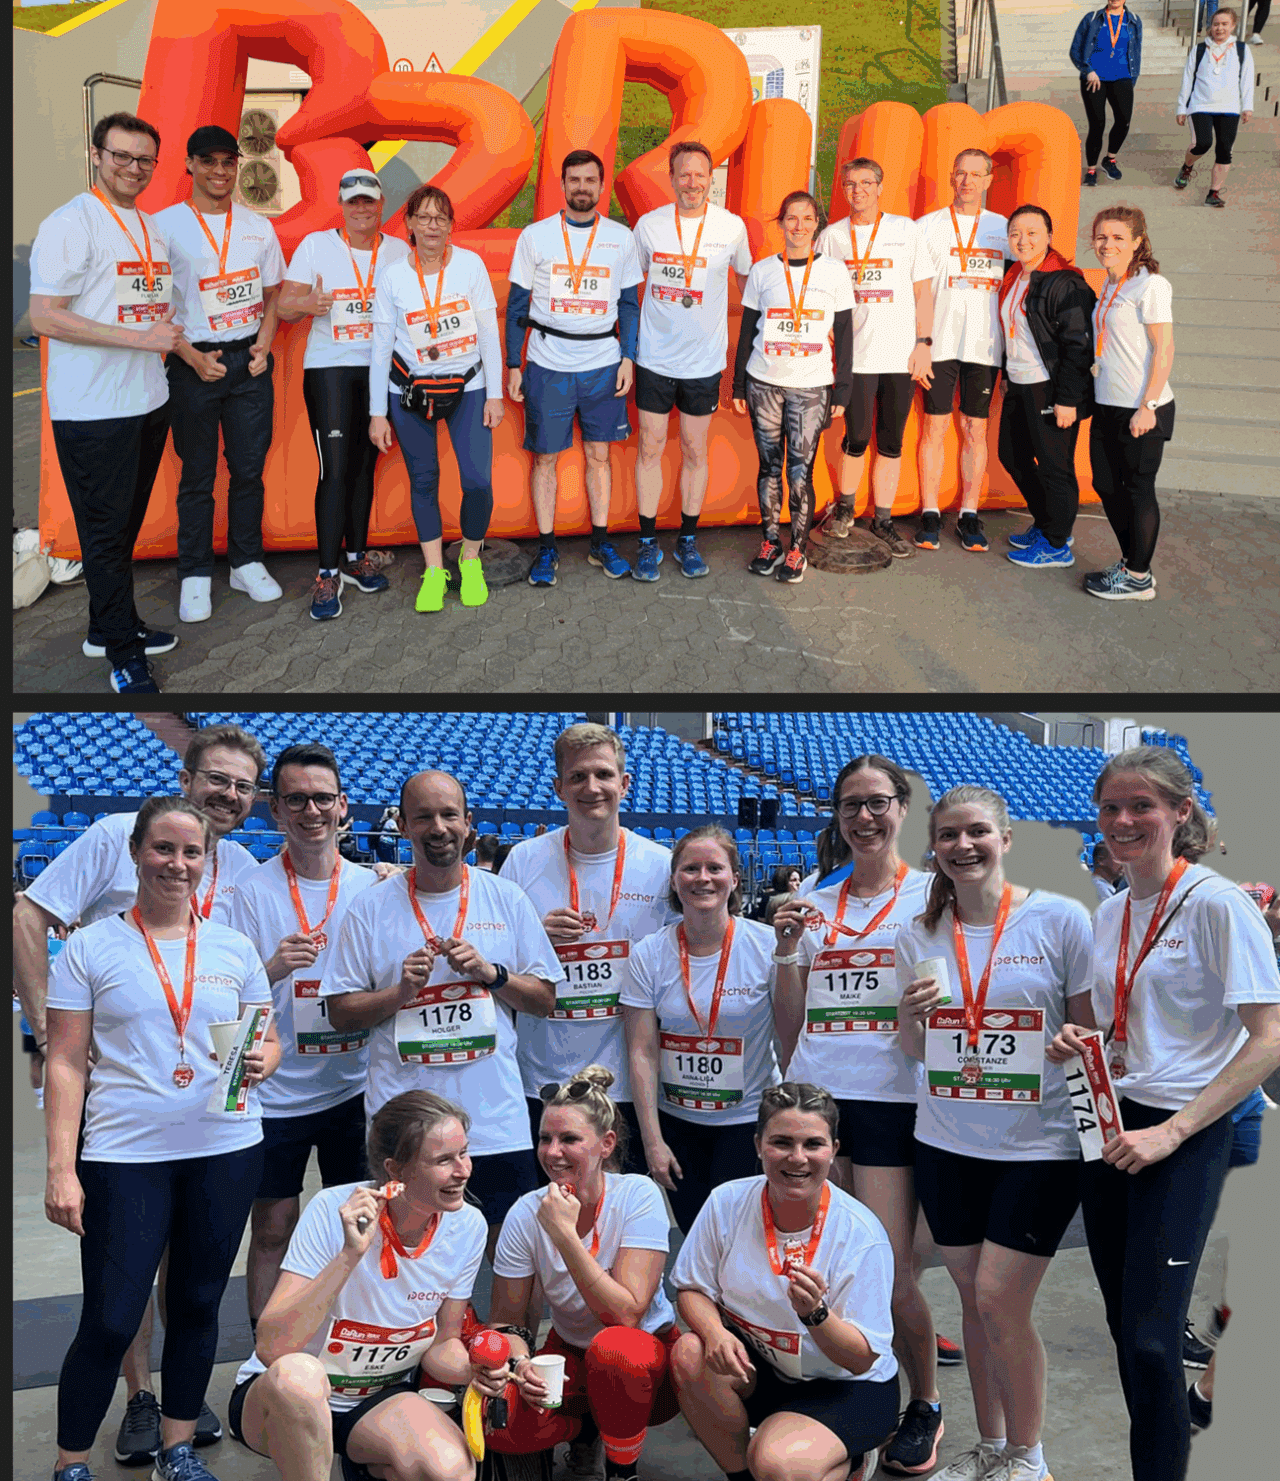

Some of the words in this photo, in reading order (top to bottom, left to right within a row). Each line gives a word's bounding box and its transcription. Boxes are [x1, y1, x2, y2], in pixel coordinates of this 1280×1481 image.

[969, 258, 991, 269] 924
[661, 266, 685, 279] 492
[227, 282, 252, 300] 927
[564, 277, 597, 291] 418
[345, 301, 373, 314] 492
[776, 320, 809, 333] 491
[563, 962, 612, 983] 1183
[573, 982, 602, 990] BASTIAN
[824, 971, 879, 992] 1175
[720, 987, 751, 997] echer
[419, 1003, 473, 1027] 1178
[432, 1025, 461, 1034] HOLGER
[223, 1045, 239, 1075] TERESA
[675, 1054, 723, 1075] 1180
[1066, 1067, 1097, 1133] 1174
[351, 1344, 411, 1362] 1176
